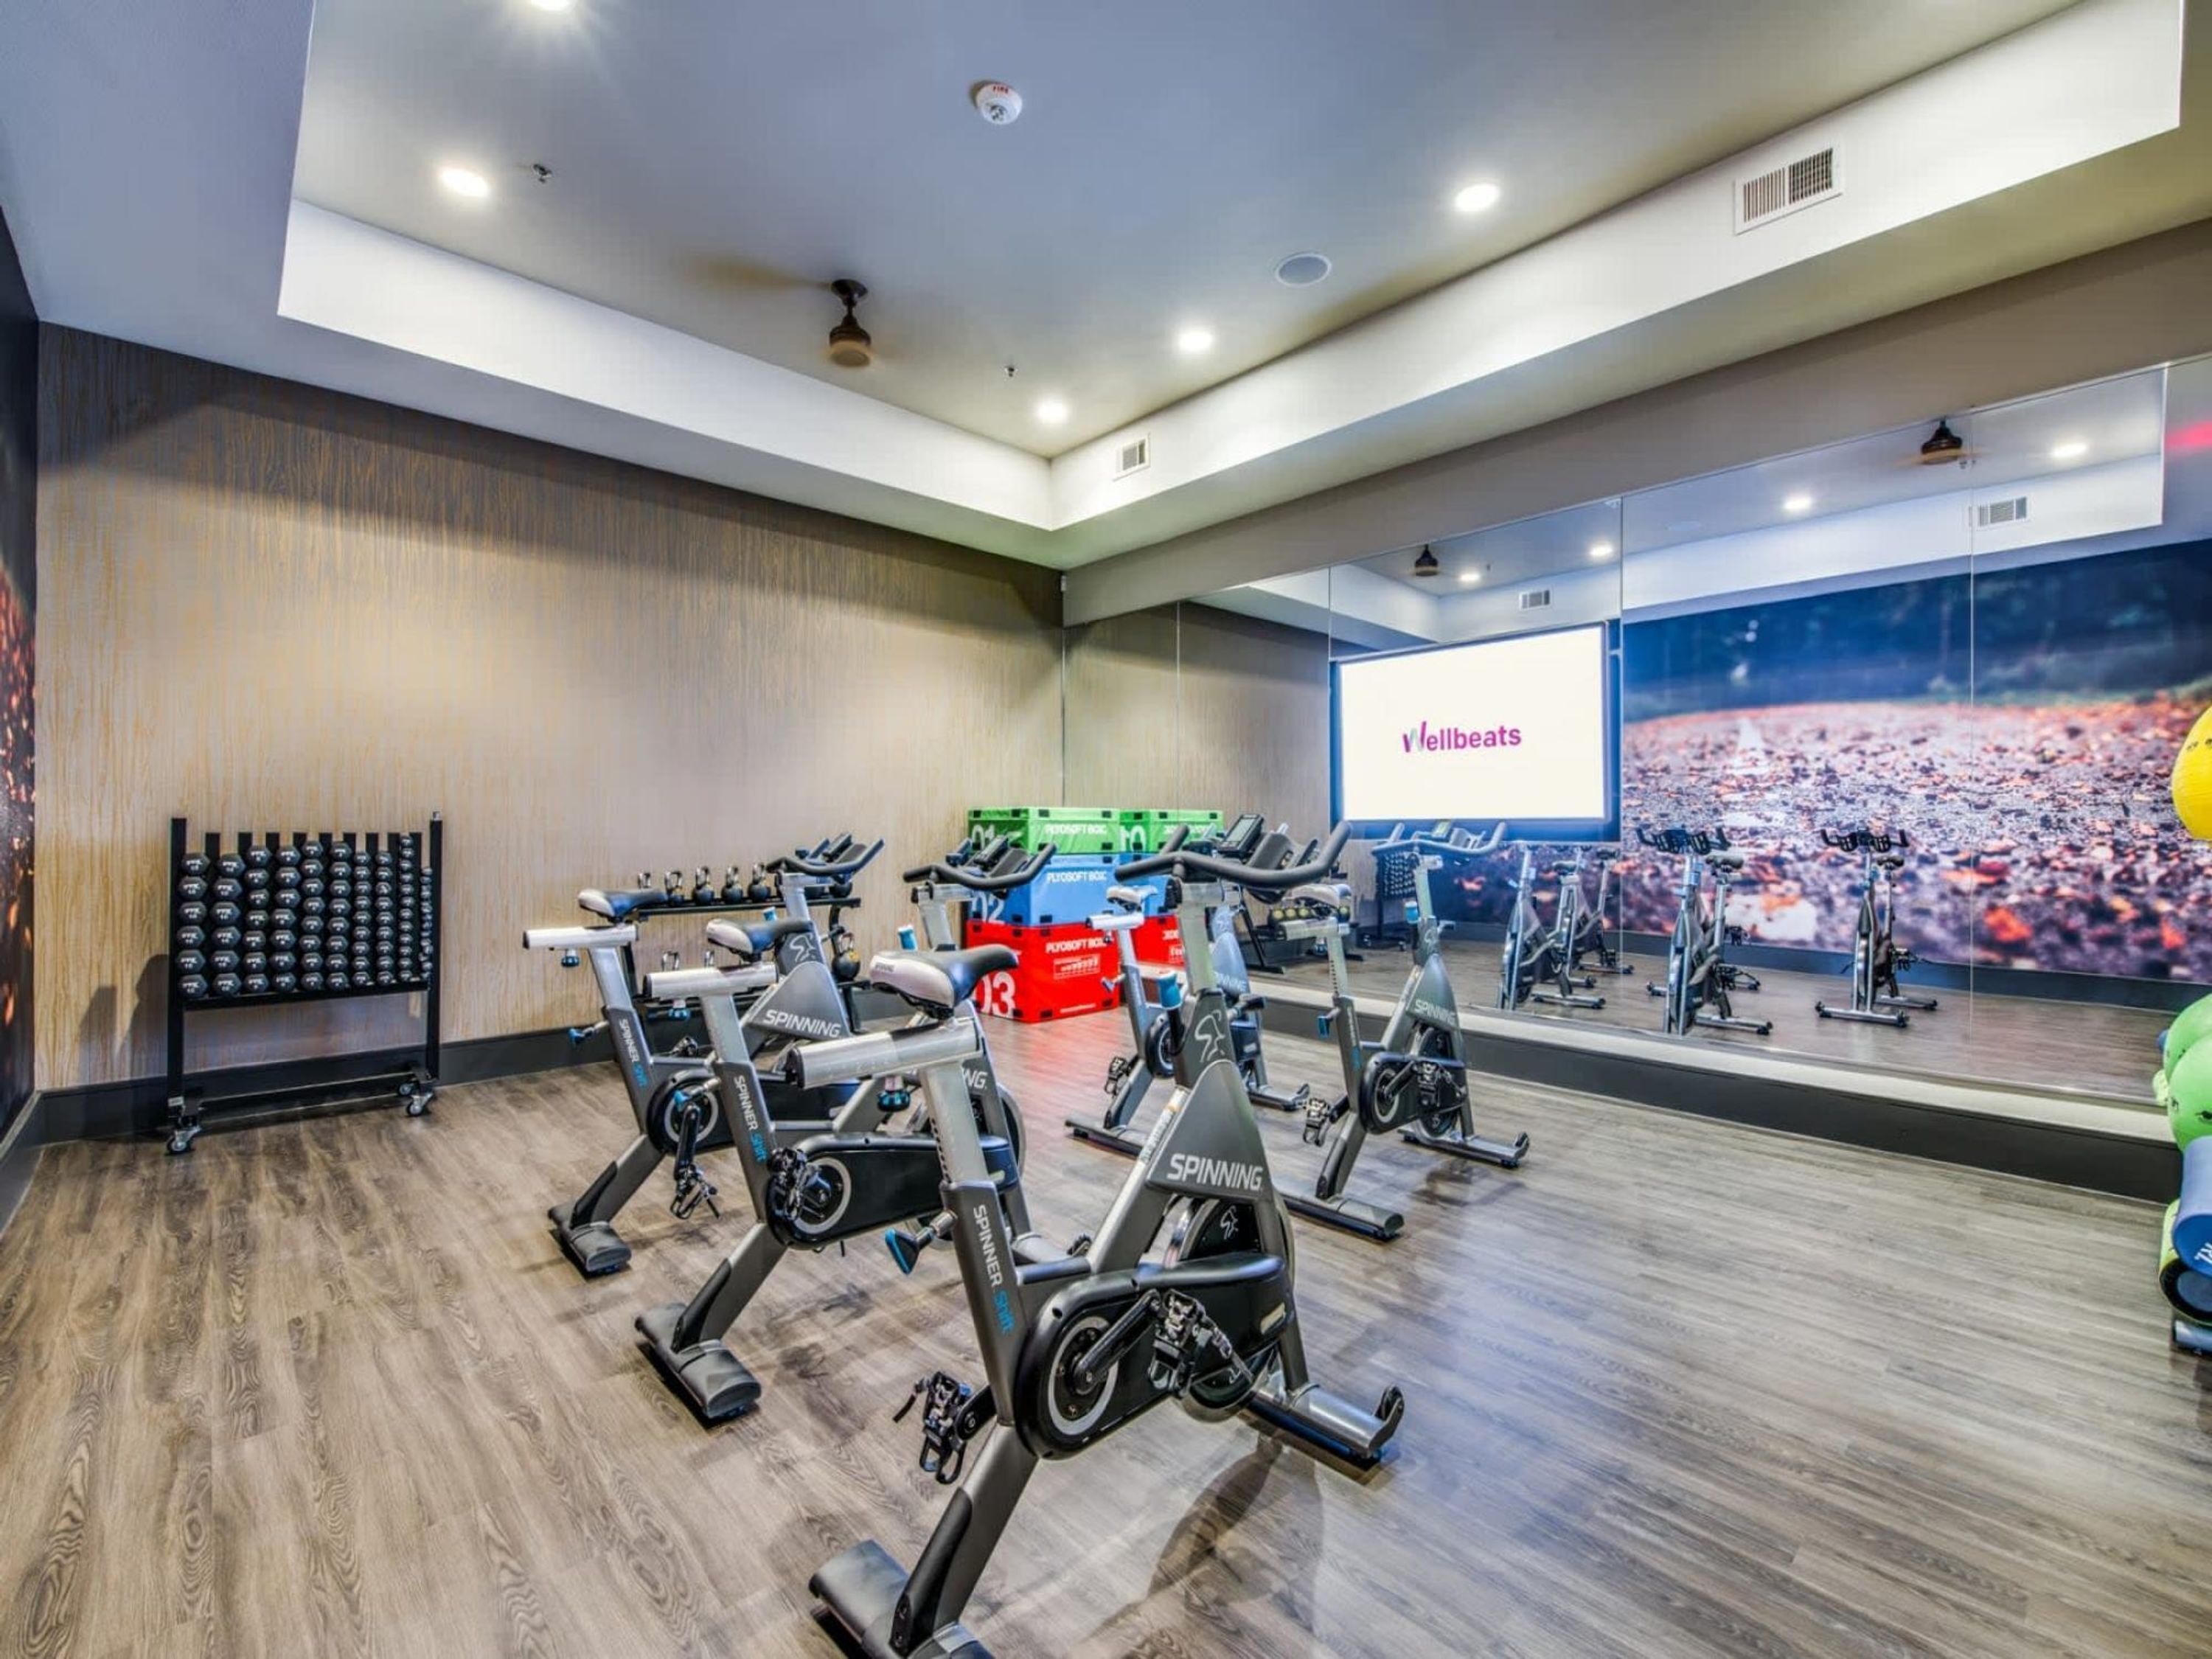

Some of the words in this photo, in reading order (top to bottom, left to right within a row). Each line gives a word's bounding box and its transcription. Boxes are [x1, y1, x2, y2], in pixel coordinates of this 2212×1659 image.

[1402, 720, 1522, 753] Wellbeats
[1046, 939, 1088, 953] PLYOSOFT
[764, 1009, 841, 1038] SPINNING
[734, 1074, 759, 1134] SPINNER
[1167, 1153, 1263, 1191] SPINNING
[973, 1204, 1004, 1288] SPINNER
